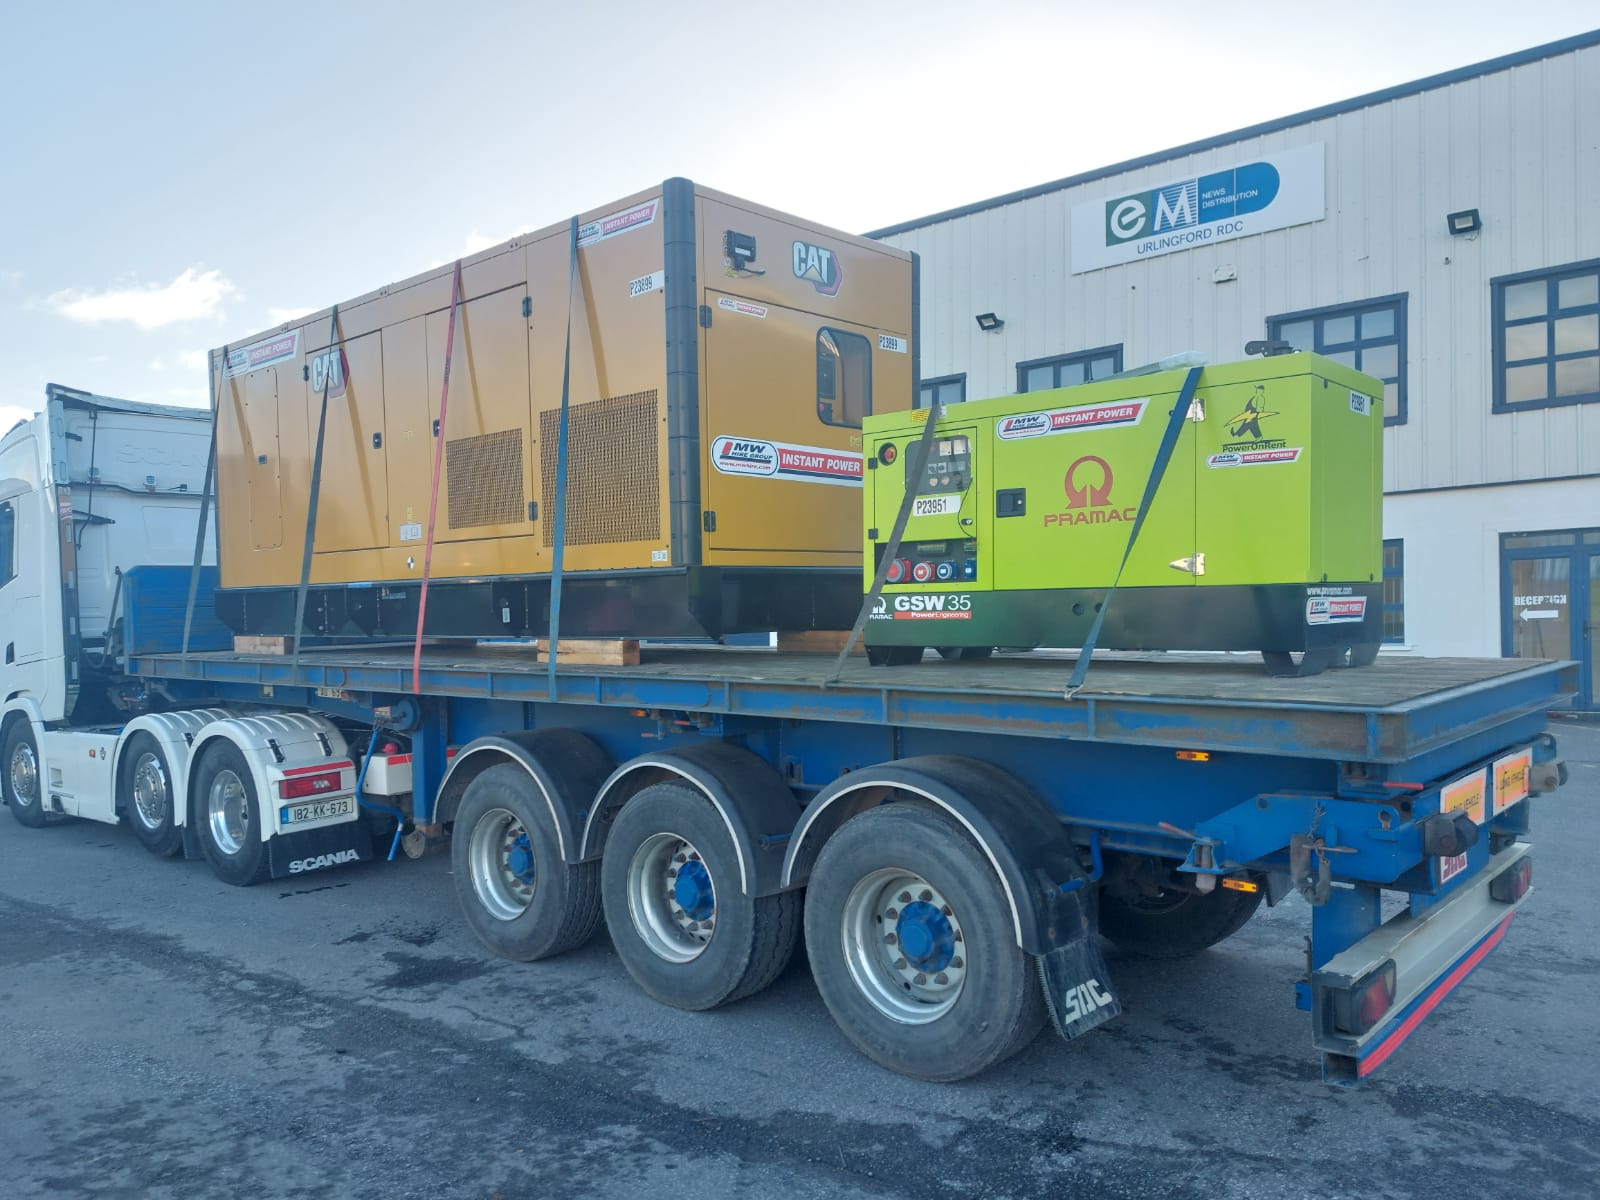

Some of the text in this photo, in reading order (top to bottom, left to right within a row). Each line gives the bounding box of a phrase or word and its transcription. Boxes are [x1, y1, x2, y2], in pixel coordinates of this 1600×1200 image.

[1201, 187, 1226, 200] NEWS
[1201, 189, 1259, 209] DISTRIBUTION
[603, 208, 650, 231] INSTANT POWER
[1136, 220, 1244, 255] URLINGFORD RDC
[793, 241, 831, 285] CAT
[630, 275, 653, 296] P23899
[312, 351, 341, 392] CAT
[1014, 416, 1040, 425] MW
[1054, 407, 1133, 426] INSTANT POWER
[731, 451, 773, 461] HIRE GROUP
[733, 442, 766, 454] MW
[1222, 441, 1287, 453] PowerOnRent
[1244, 451, 1294, 462] INSTANT POWER
[782, 453, 861, 473] INSTANT POWER
[916, 499, 947, 515] P23951
[1044, 507, 1137, 528] PRAMAC
[894, 594, 972, 612] GSW 35
[1513, 594, 1567, 606] RECEPTION
[294, 801, 349, 820] 182-KK-673
[289, 849, 361, 874] SCANIA
[1065, 978, 1113, 1025] SDC
